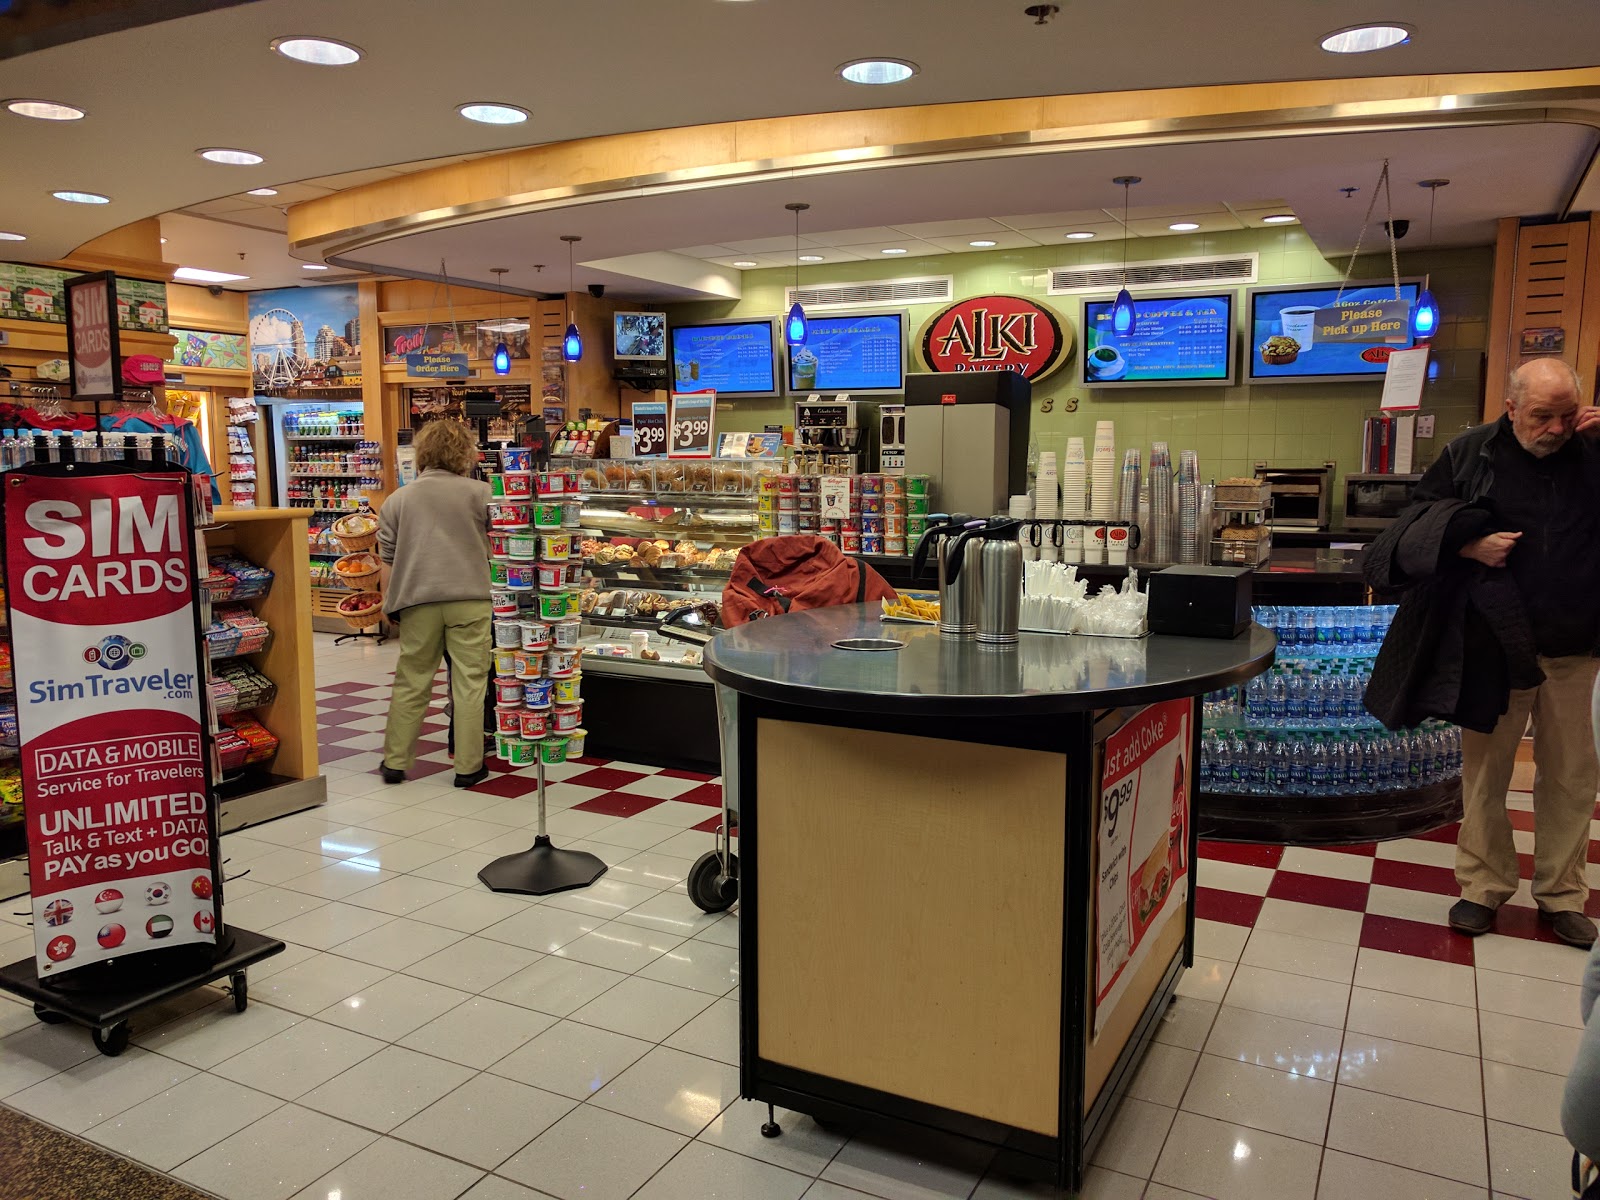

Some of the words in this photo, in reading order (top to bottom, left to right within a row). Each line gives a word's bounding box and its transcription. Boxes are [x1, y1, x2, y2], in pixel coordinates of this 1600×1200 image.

[72, 285, 108, 329] SIM
[1341, 309, 1382, 320] Please
[74, 328, 110, 354] CARDS
[394, 328, 425, 355] Trolli
[936, 308, 1038, 362] ALKI
[1323, 325, 1348, 336] Pick
[1352, 324, 1368, 334] up
[1370, 321, 1401, 331] Here
[1368, 350, 1390, 358] ALK
[23, 495, 182, 560] SIM
[22, 558, 188, 602] CARDS
[30, 668, 194, 704] SimTraveler
[163, 688, 193, 699] .com
[38, 748, 102, 774] DATA
[105, 746, 120, 764] &
[124, 739, 198, 761] MOBILE
[1103, 748, 1121, 780] ust
[1123, 732, 1141, 766] add
[37, 778, 102, 798] Service
[106, 772, 132, 788] for
[135, 763, 204, 783] Travelers
[39, 792, 207, 837] UNLIMITED
[42, 835, 82, 857] Talk
[87, 832, 102, 848] &
[104, 828, 143, 847] Text
[147, 828, 158, 838] +
[162, 818, 208, 837] DATA
[44, 853, 91, 881] PAY
[94, 852, 122, 870] as
[125, 846, 168, 870] you
[171, 838, 210, 858] GO!
